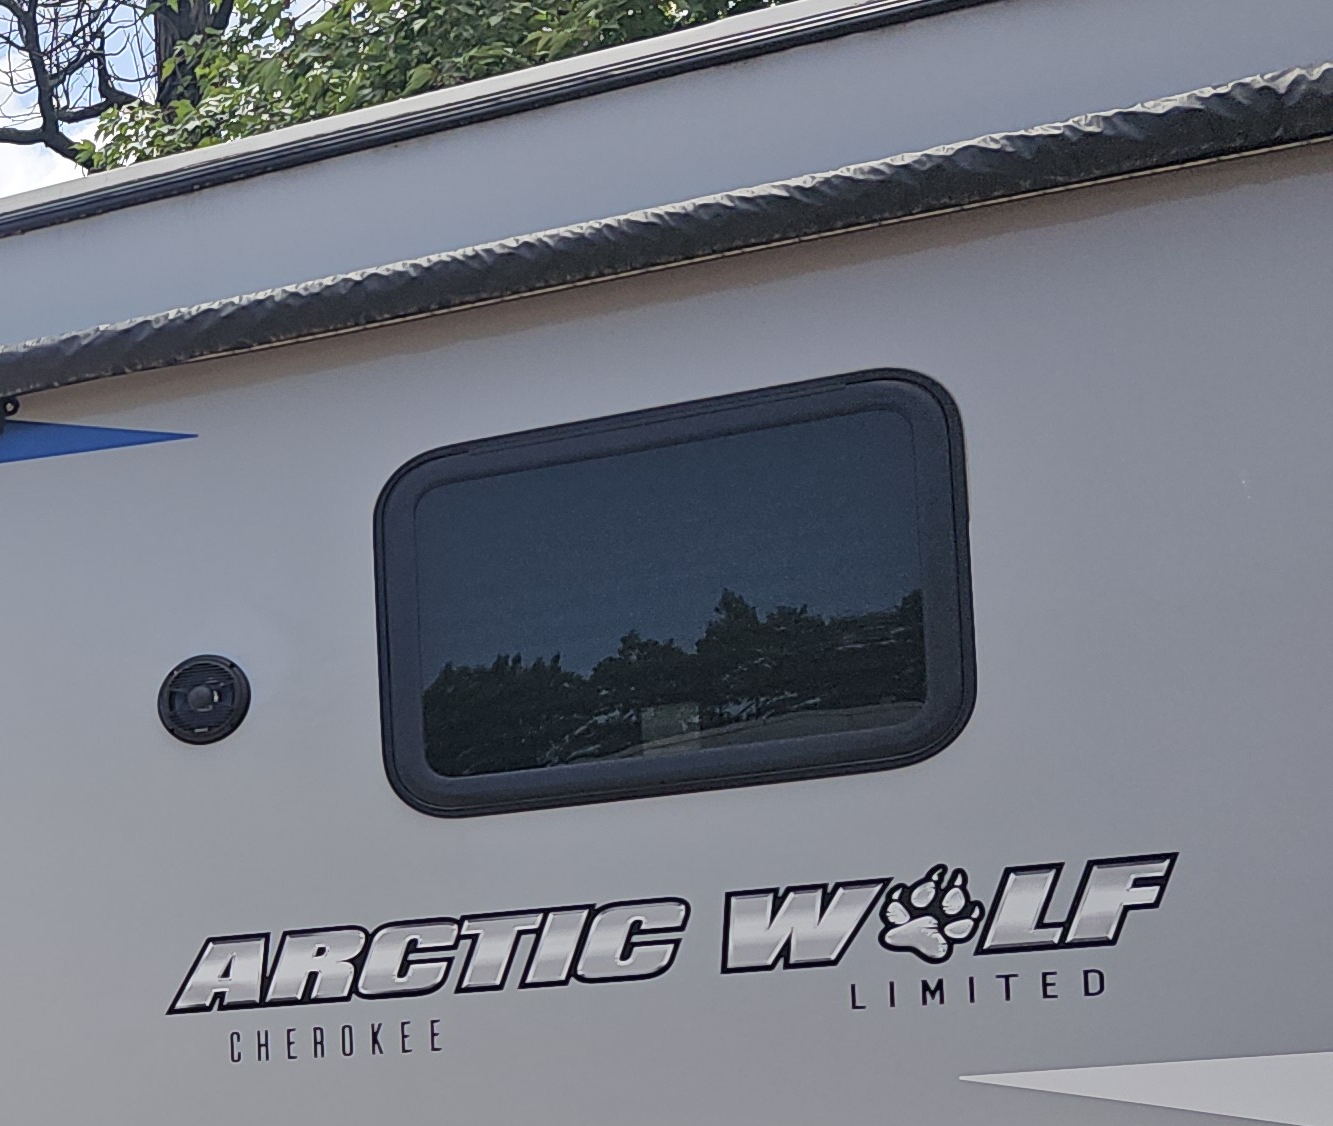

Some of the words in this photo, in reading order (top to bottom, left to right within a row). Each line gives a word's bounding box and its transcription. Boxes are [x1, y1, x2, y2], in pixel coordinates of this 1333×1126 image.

[166, 896, 692, 1015] ARCTIC
[850, 968, 1106, 1010] LIMITED
[229, 1019, 444, 1064] CHEROKEE
